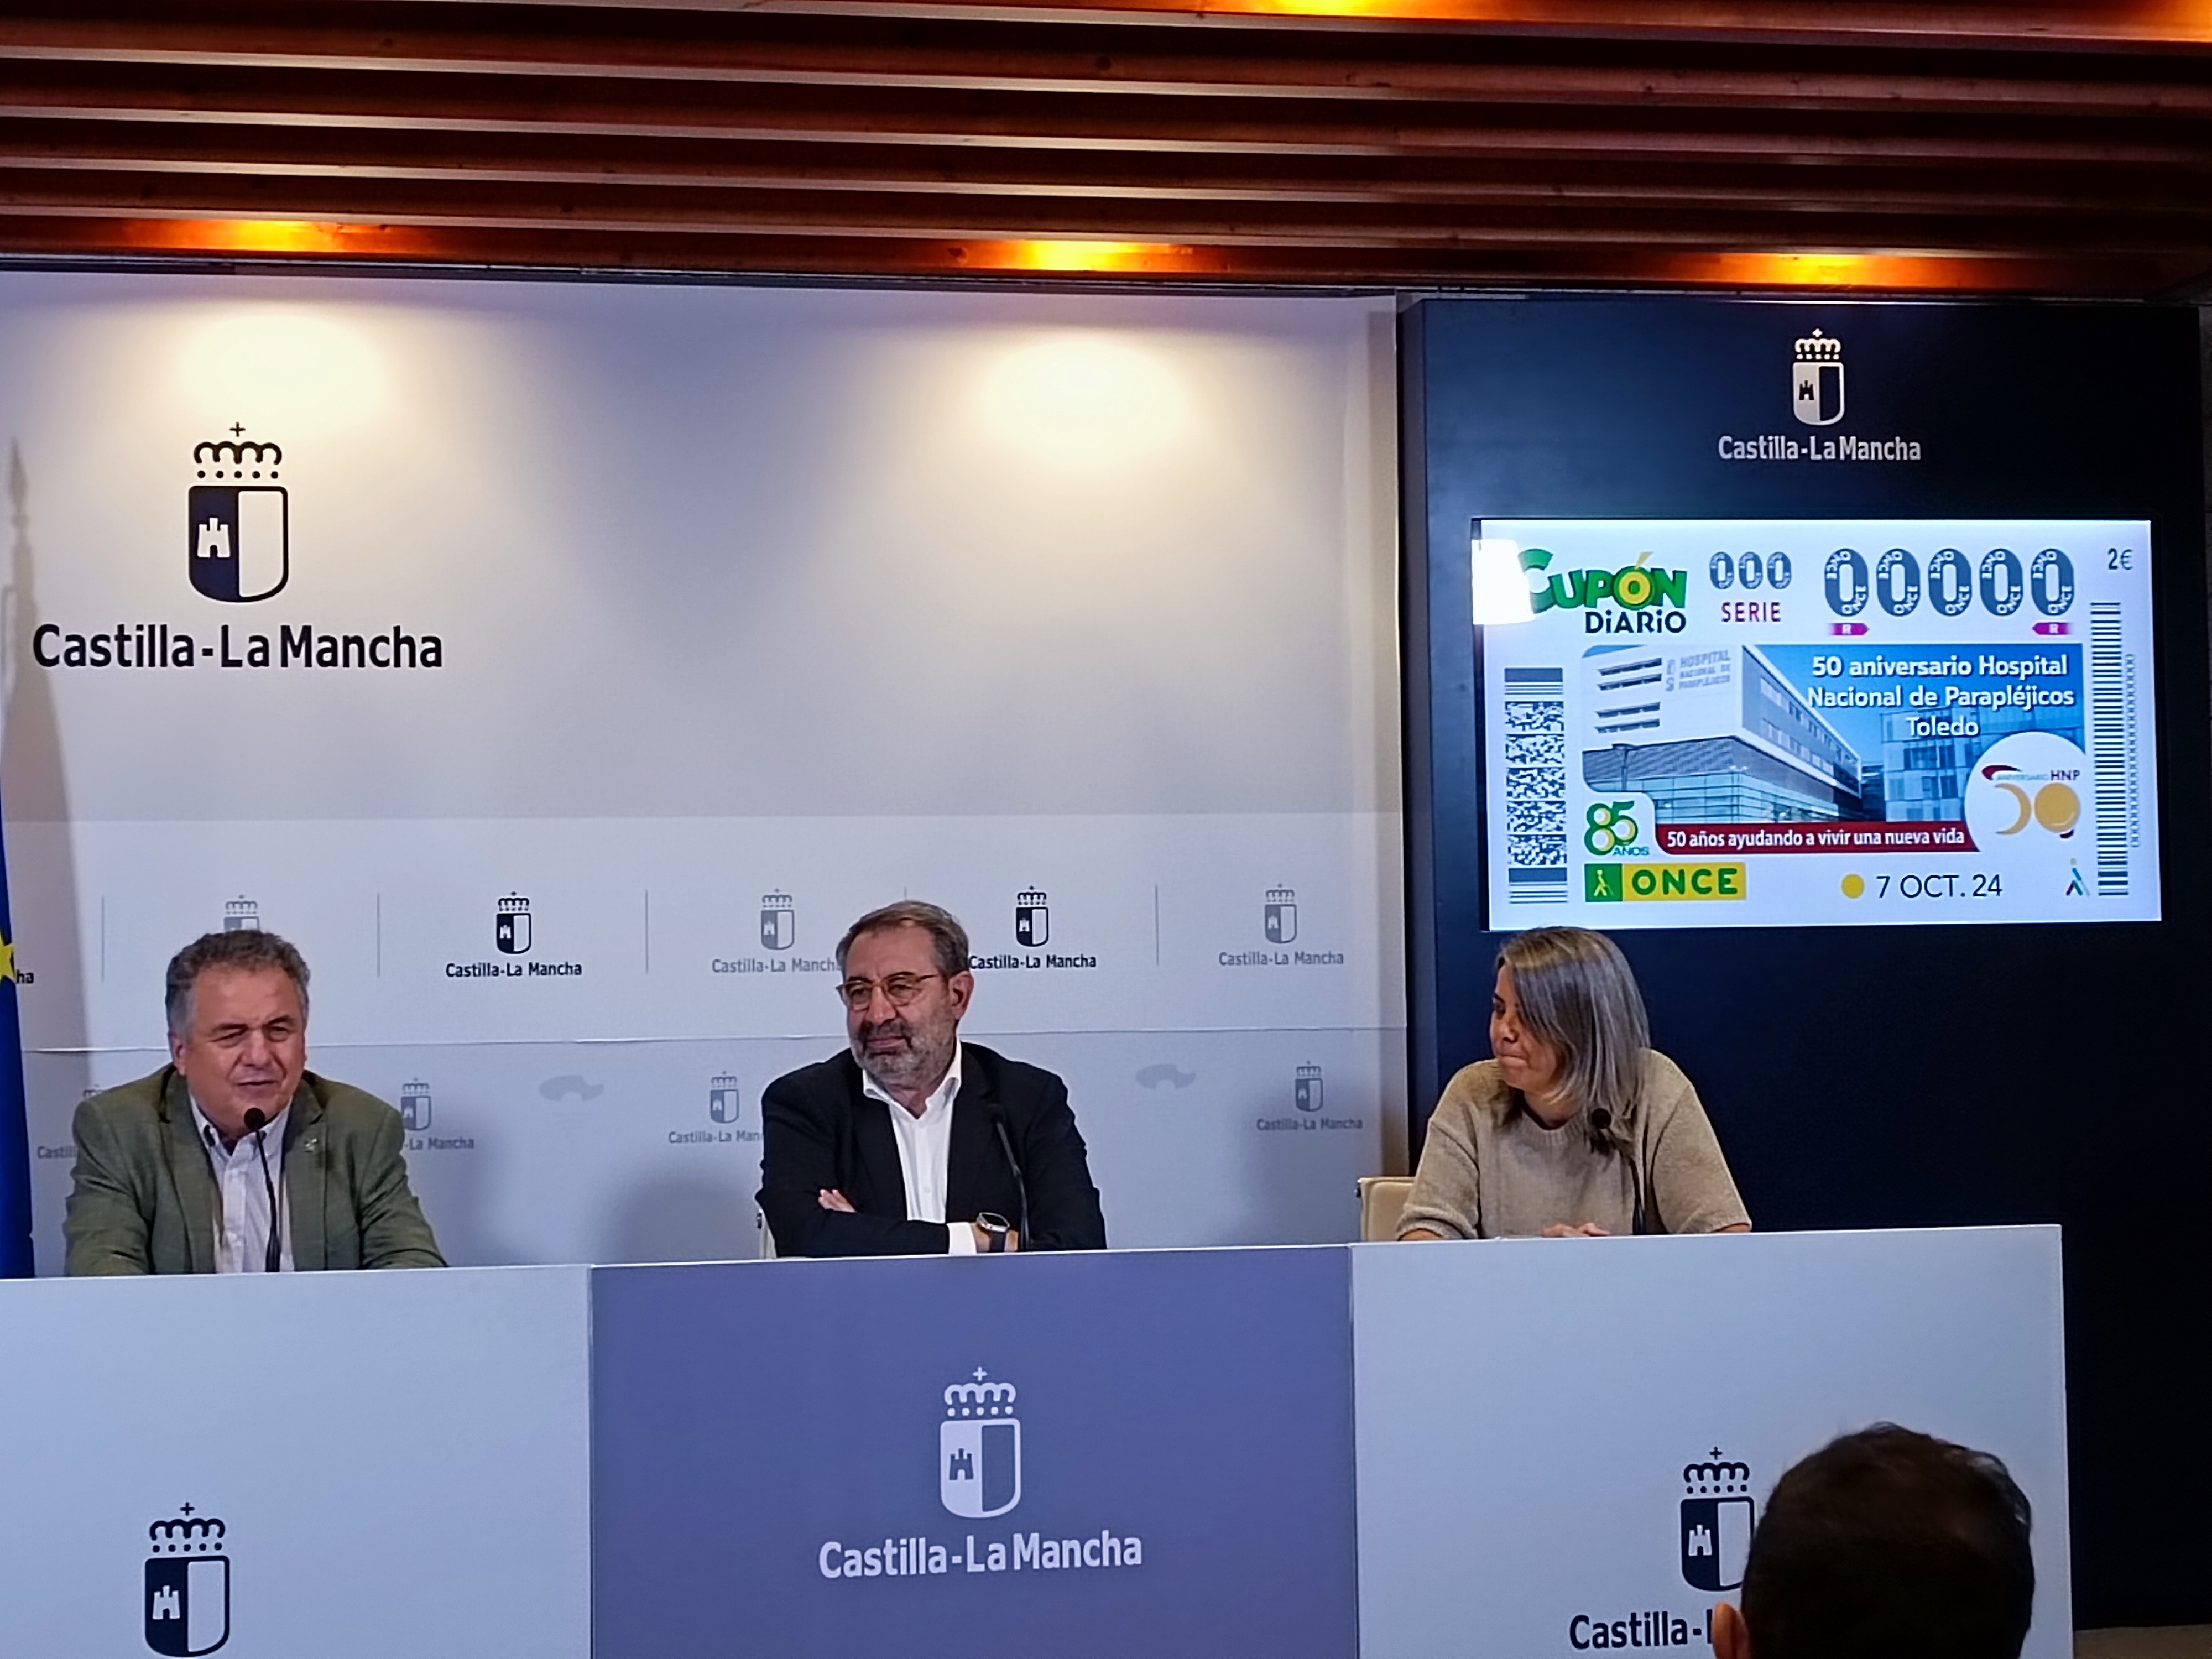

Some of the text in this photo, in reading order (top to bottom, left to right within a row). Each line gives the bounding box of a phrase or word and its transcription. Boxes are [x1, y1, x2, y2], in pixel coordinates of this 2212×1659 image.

[1718, 435, 1922, 461] Castilla-La Mancha
[1709, 551, 1792, 589] 000
[2107, 547, 2133, 570] 2€
[1824, 547, 2074, 617] 00000
[1721, 601, 1781, 623] SERIE
[33, 624, 442, 668] Castilla-La Mancha
[1812, 654, 2068, 681] 50 aniversario Hospital
[1807, 684, 2075, 711] Nacional de Parapléjicos
[1906, 714, 1979, 737] Toledo
[2050, 769, 2080, 781] HNP
[1584, 800, 1639, 856] 85
[1667, 827, 1965, 851] 50 años ayudando a vivir una nueva vida
[1632, 868, 1738, 895] ONCE
[1876, 874, 2003, 899] 7 OCT. 24
[445, 961, 582, 978] Castilla-La Mancha
[712, 957, 786, 973] Castilla-La
[968, 953, 1097, 969] Castilla-La Mancha
[1218, 950, 1344, 967] Castilla-La Mancha
[427, 1135, 474, 1150] Mancha
[668, 1129, 763, 1144] Castilla-La Man
[818, 1530, 1142, 1579] Castilla-La Mancha
[1569, 1609, 1713, 1650] Castilla-
